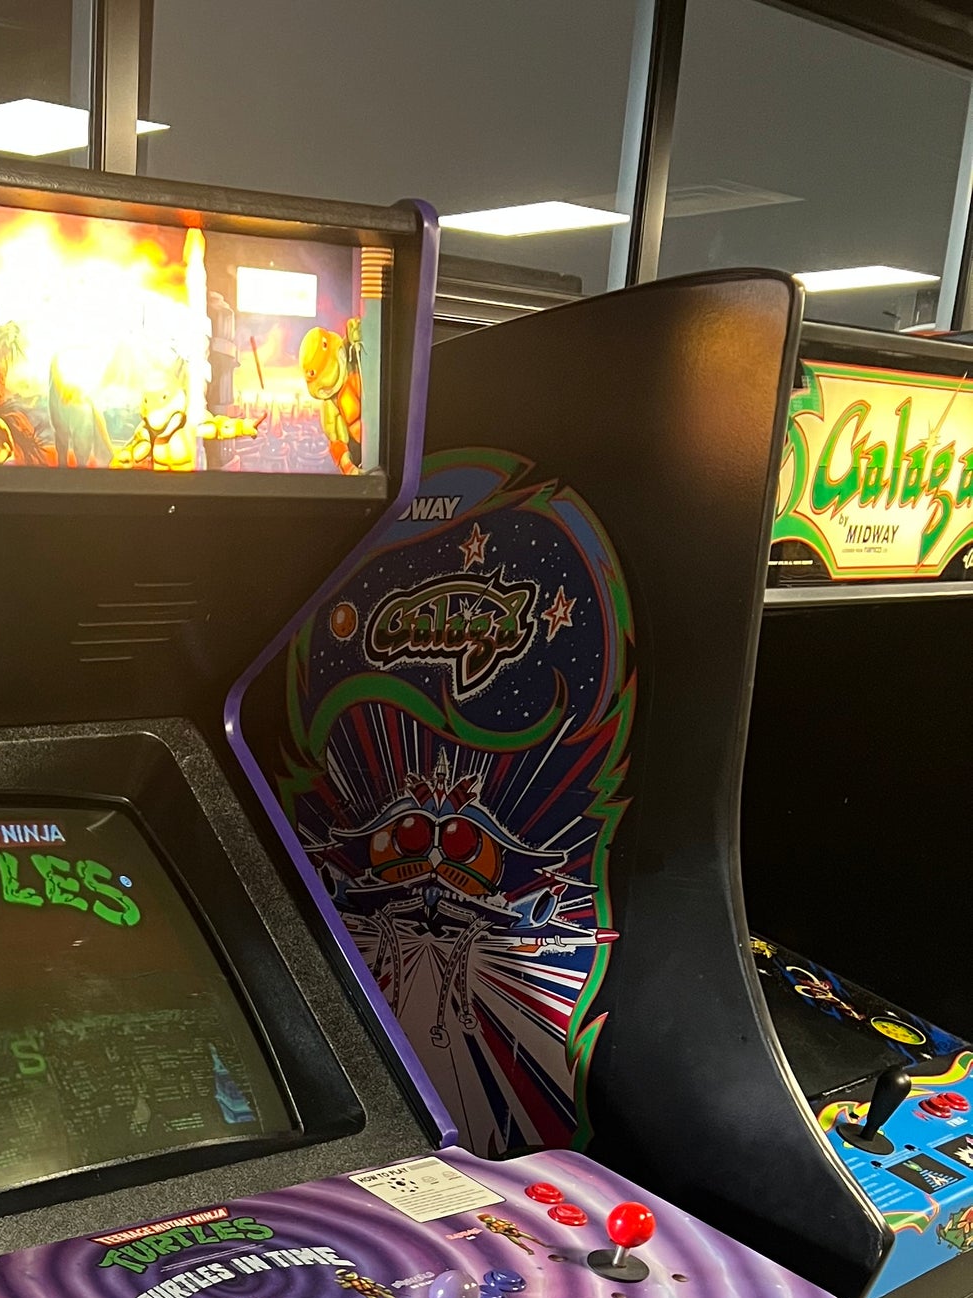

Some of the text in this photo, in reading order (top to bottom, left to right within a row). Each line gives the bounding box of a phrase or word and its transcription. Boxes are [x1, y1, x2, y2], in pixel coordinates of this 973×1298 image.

[838, 513, 849, 528] by
[845, 525, 899, 544] MIDWAY
[372, 579, 529, 687] Galaga
[357, 1173, 378, 1184] HOW
[389, 1167, 409, 1177] PLAY
[96, 1208, 227, 1245] TEENAGE MUTANT NINJA
[98, 1216, 274, 1274] TURTLES
[230, 1254, 272, 1275] IN
[261, 1246, 356, 1268] TIME
